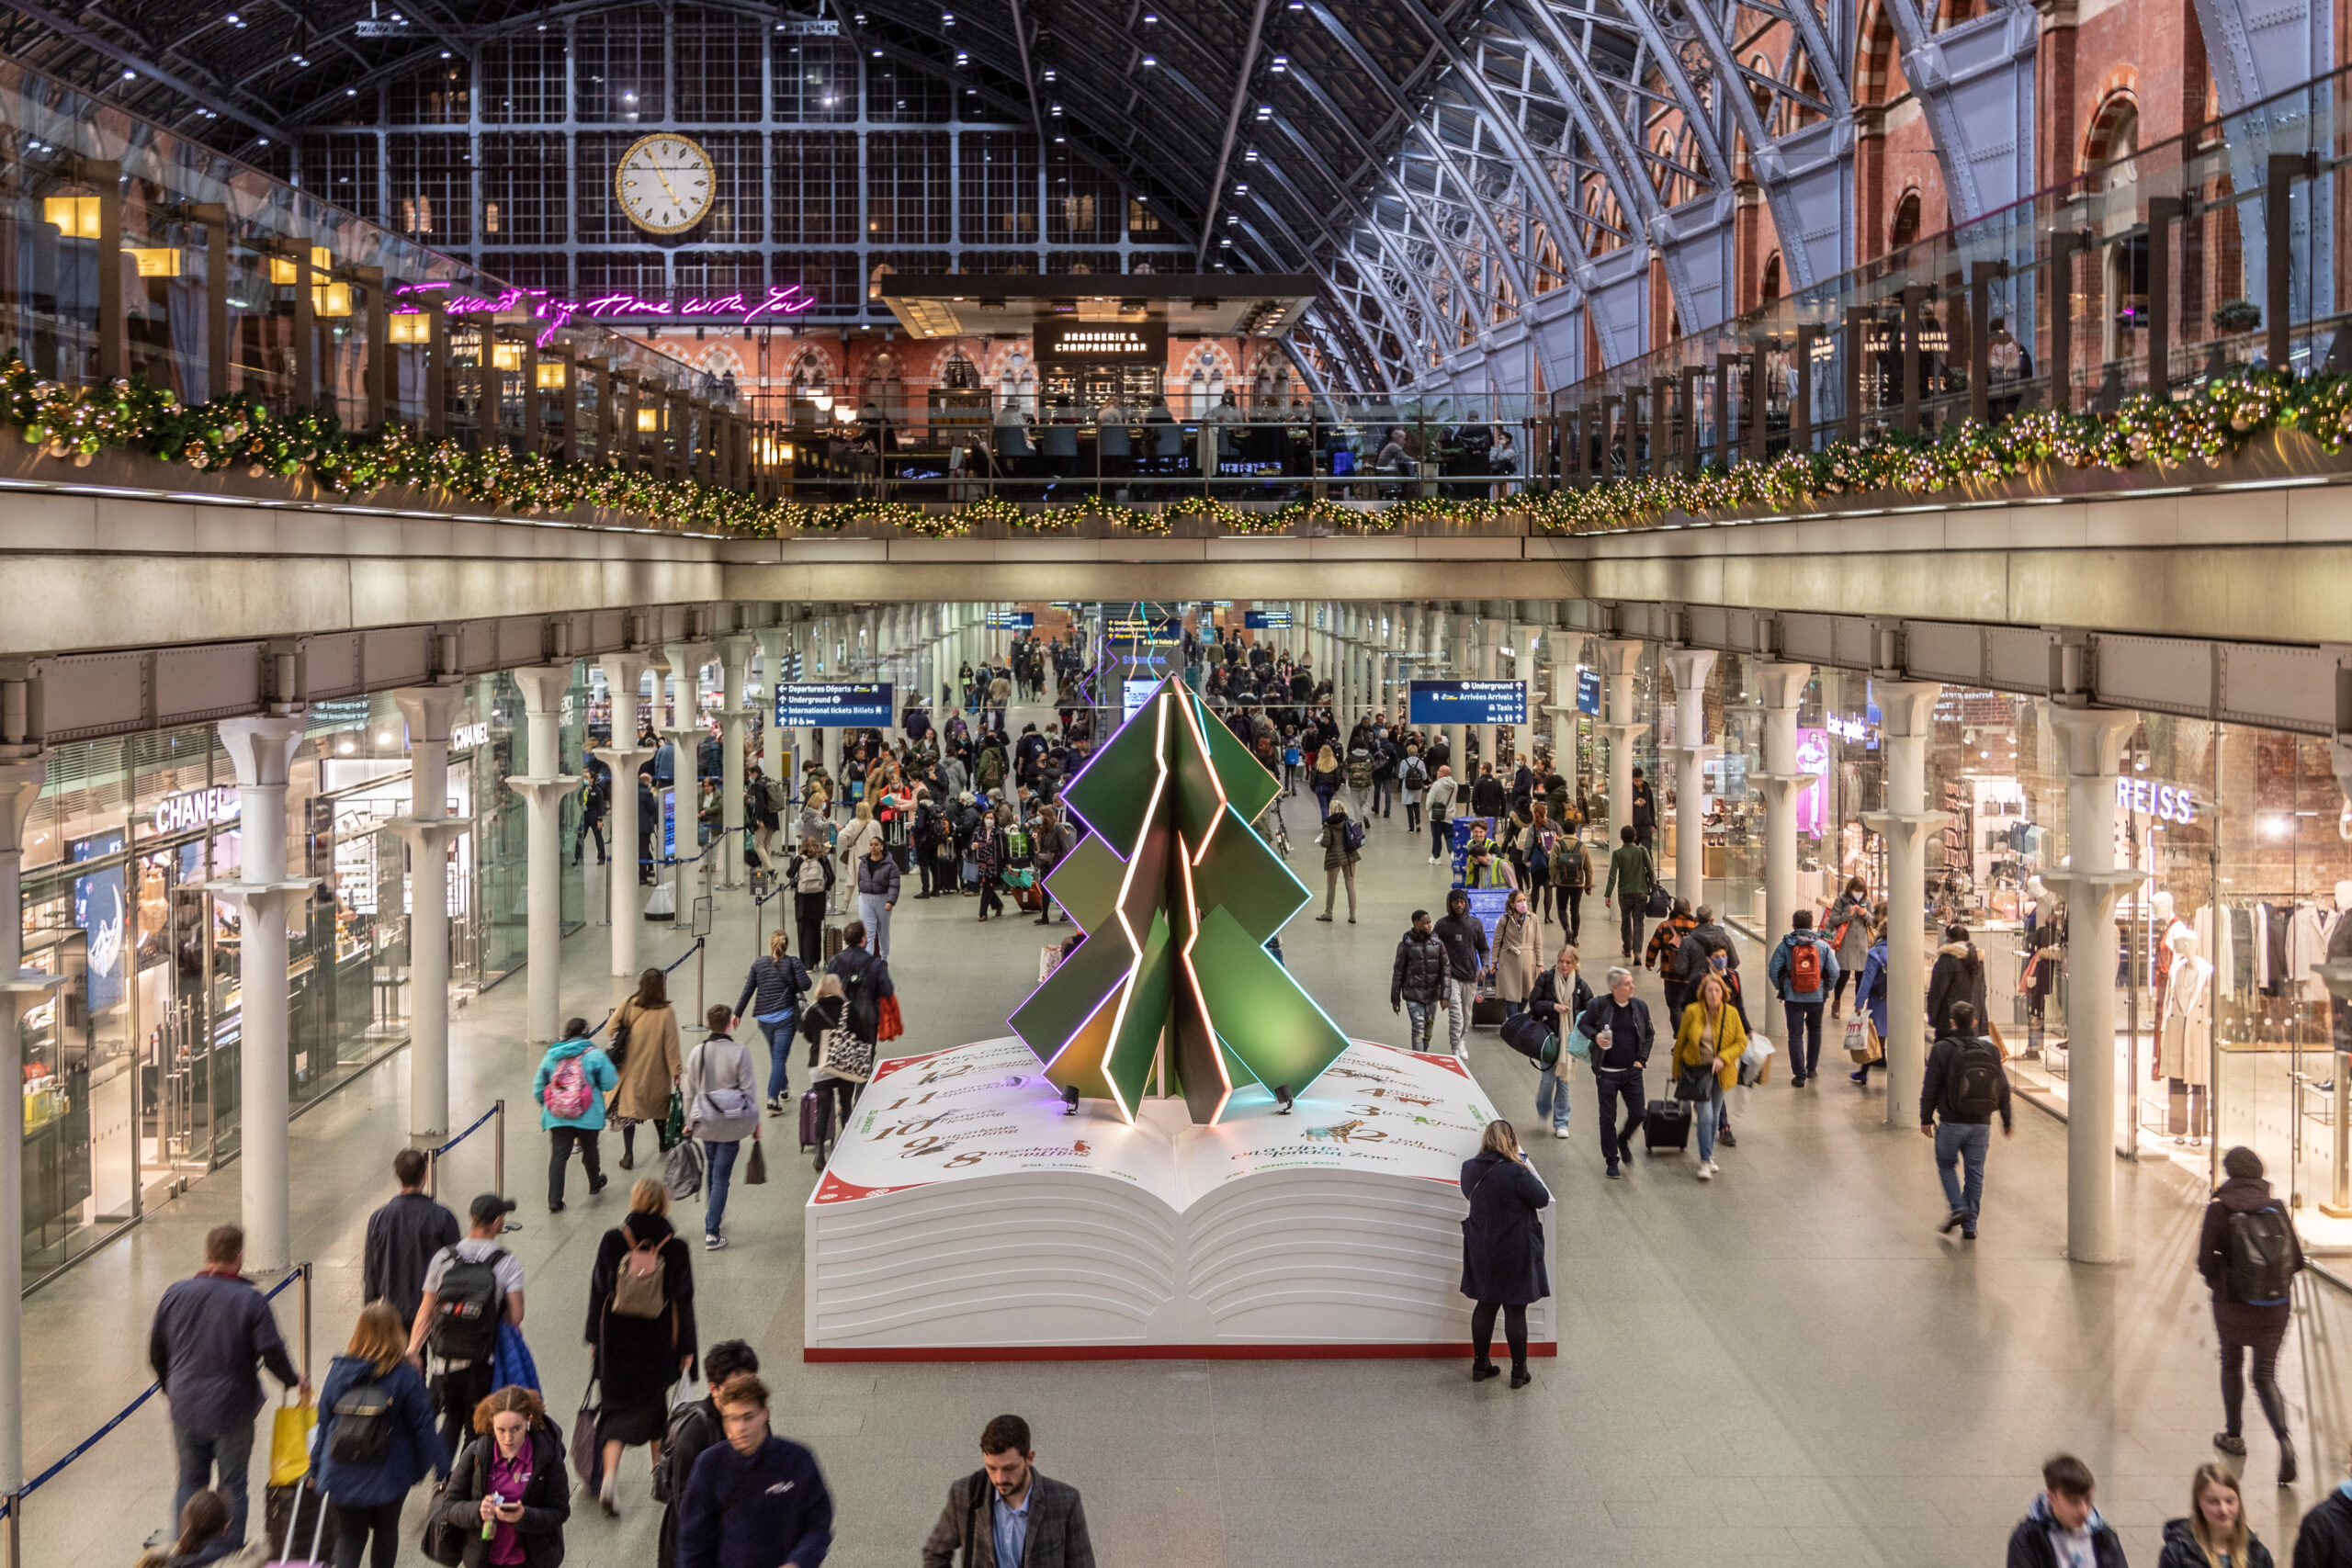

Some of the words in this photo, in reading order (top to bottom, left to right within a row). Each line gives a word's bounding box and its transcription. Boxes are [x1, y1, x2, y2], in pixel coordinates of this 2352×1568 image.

[742, 284, 814, 324] You
[1063, 333, 1127, 342] BRASSERIE
[1054, 343, 1123, 352] CHAMPAGNE
[1125, 343, 1148, 352] BAR
[788, 685, 825, 694] Departures
[826, 684, 852, 694] Départs
[1471, 682, 1514, 691] Underground
[788, 695, 831, 705] Underground
[788, 706, 830, 715] International
[831, 706, 853, 715] tickets
[853, 706, 874, 715] Billets
[454, 721, 490, 751] CHANEL
[2116, 775, 2192, 825] REISS
[155, 787, 223, 834] CHANEL
[1356, 1088, 1389, 1098] 4
[880, 1090, 939, 1111] 11
[1345, 1104, 1381, 1116] 3
[864, 1119, 934, 1142] 10
[1348, 1129, 1388, 1143] 2
[898, 1135, 940, 1156] 9
[943, 1151, 988, 1168] 8
